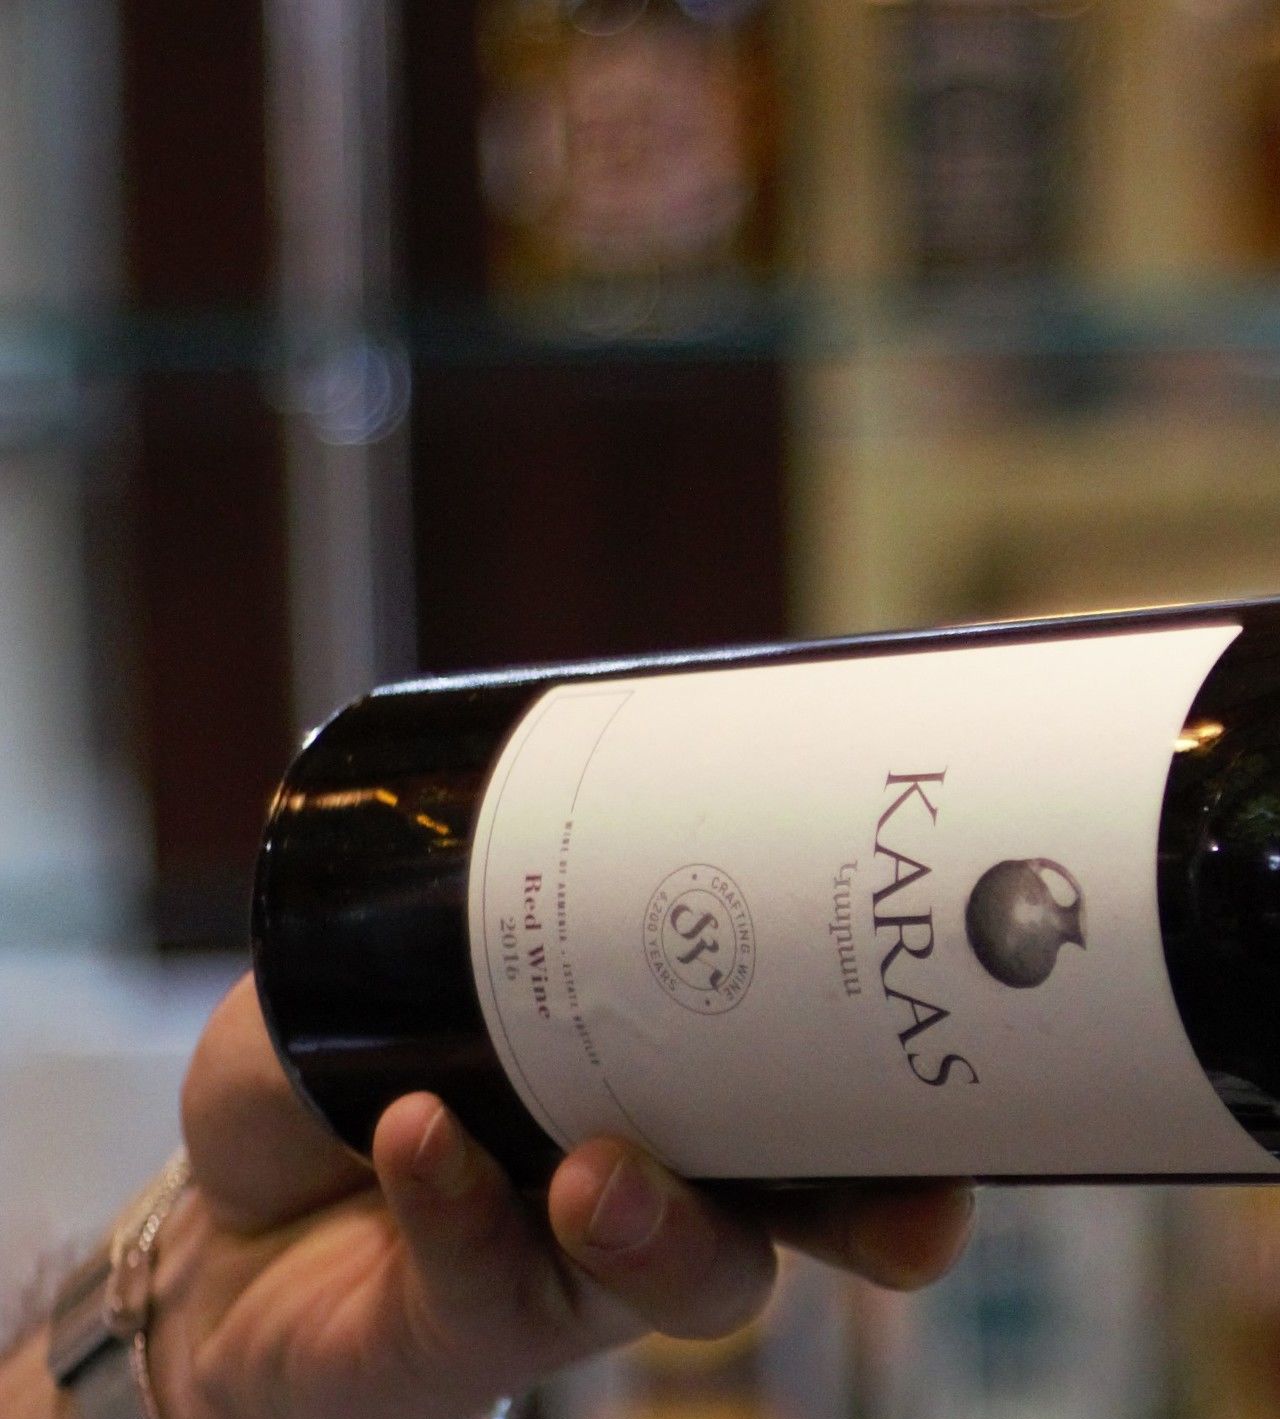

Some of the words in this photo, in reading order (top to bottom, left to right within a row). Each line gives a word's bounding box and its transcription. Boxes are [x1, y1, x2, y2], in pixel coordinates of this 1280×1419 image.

[524, 874, 543, 930] Red
[711, 876, 750, 954] CRAFTING
[872, 765, 979, 1087] KARAS
[500, 917, 519, 981] 2016
[528, 944, 551, 1018] Wine
[649, 941, 677, 992] YEARS
[723, 963, 748, 1000] WINE
